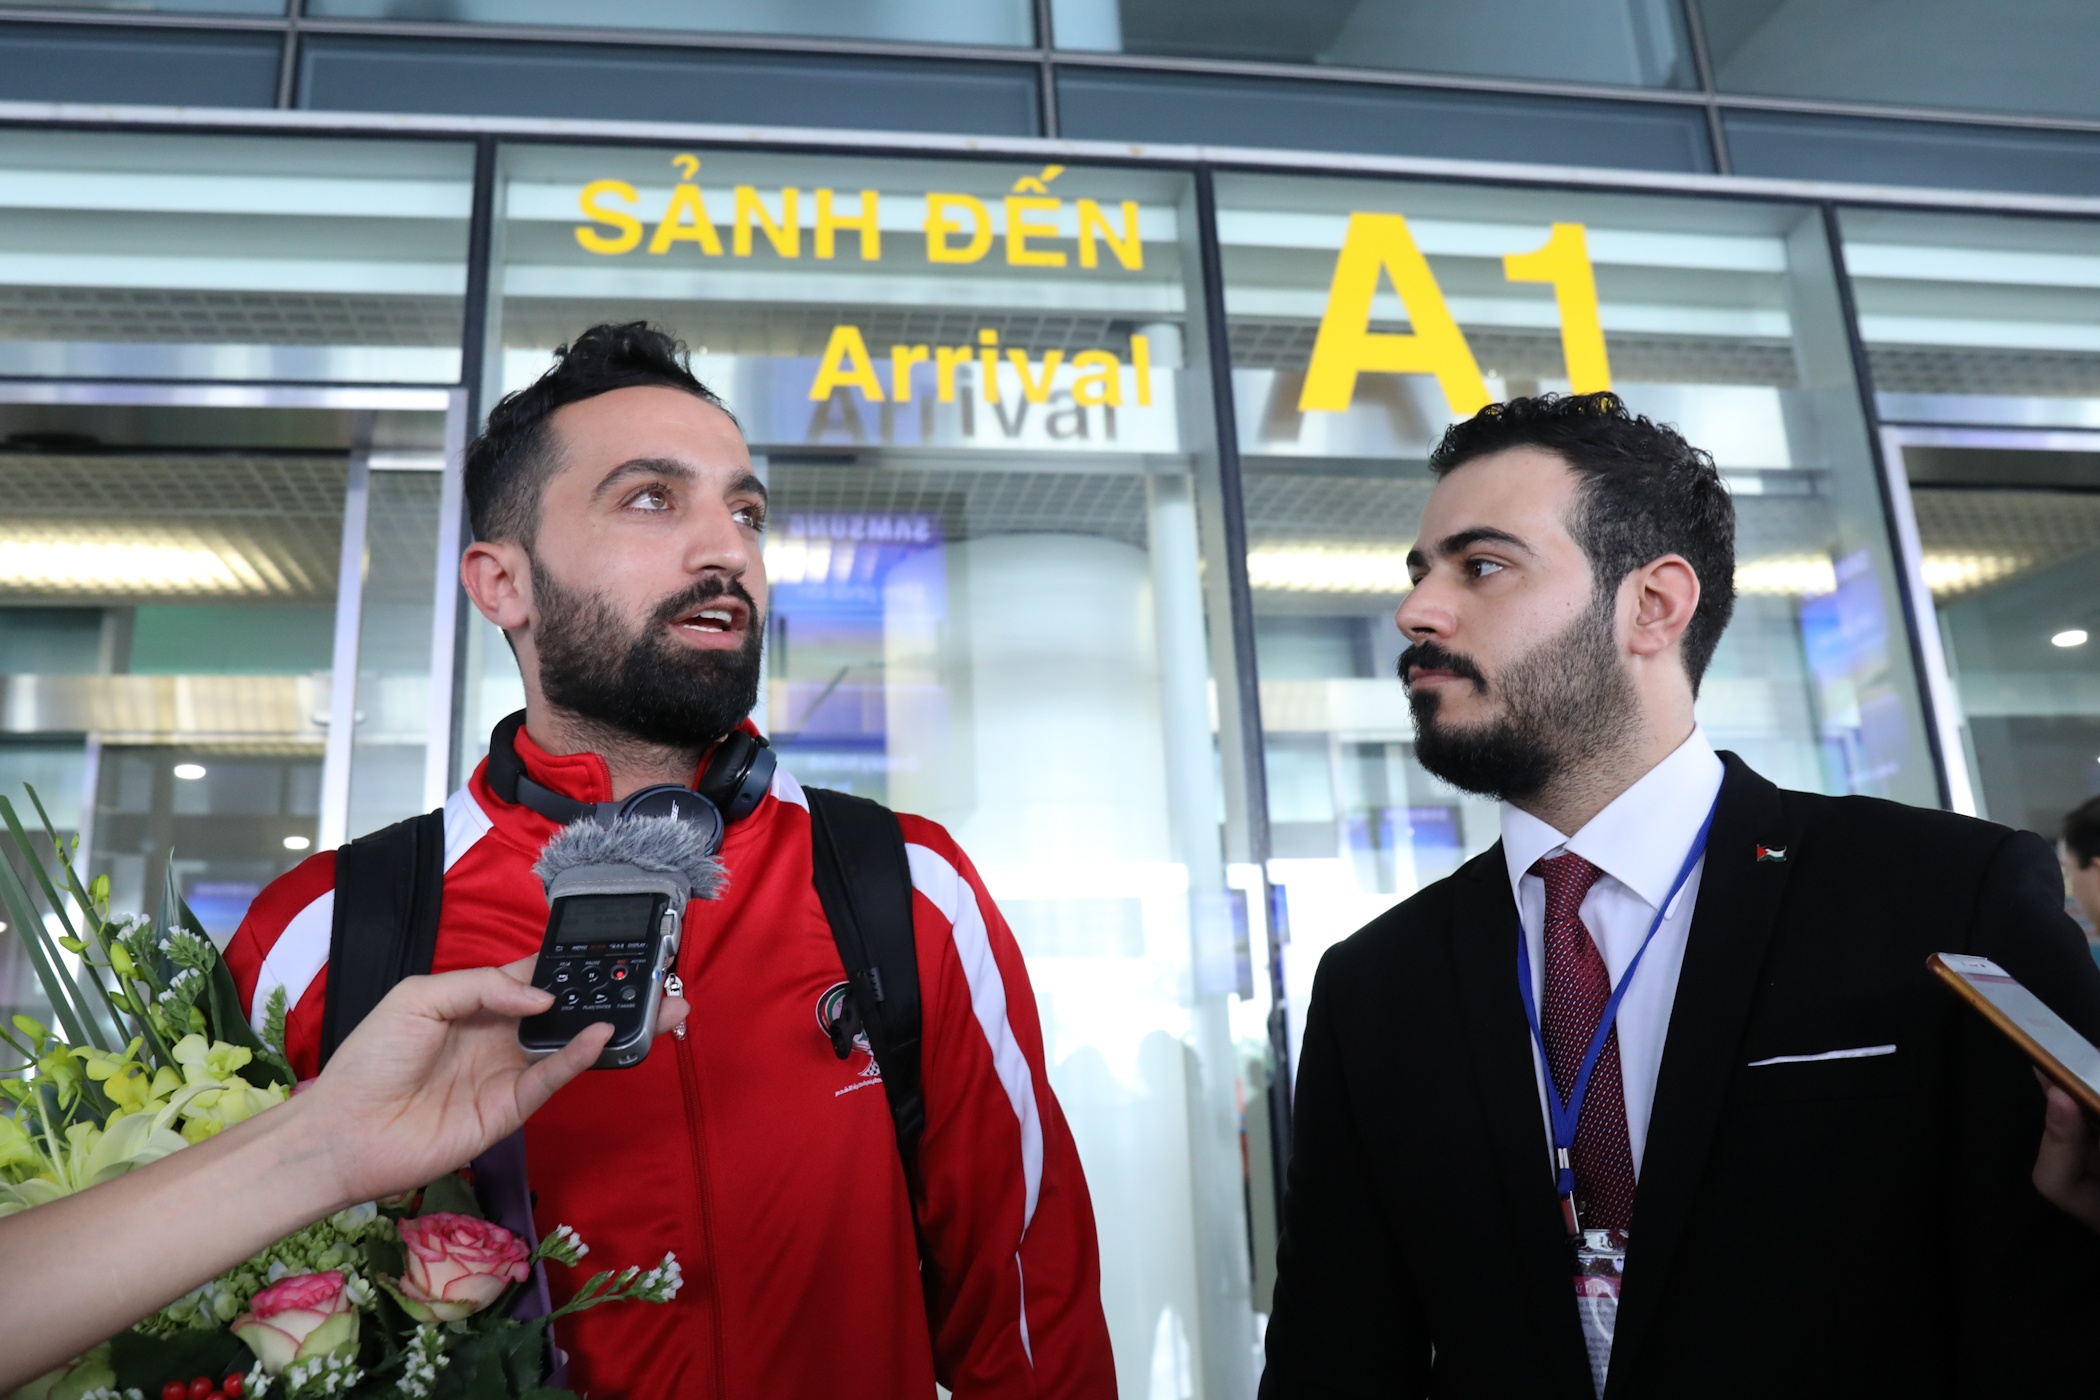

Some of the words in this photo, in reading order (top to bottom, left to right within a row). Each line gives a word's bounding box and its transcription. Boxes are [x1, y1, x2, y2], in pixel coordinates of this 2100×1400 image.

[575, 154, 881, 261] SẢNH
[923, 165, 1143, 270] ĐẾN
[808, 326, 1152, 407] Arrival
[1298, 211, 1612, 416] A1
